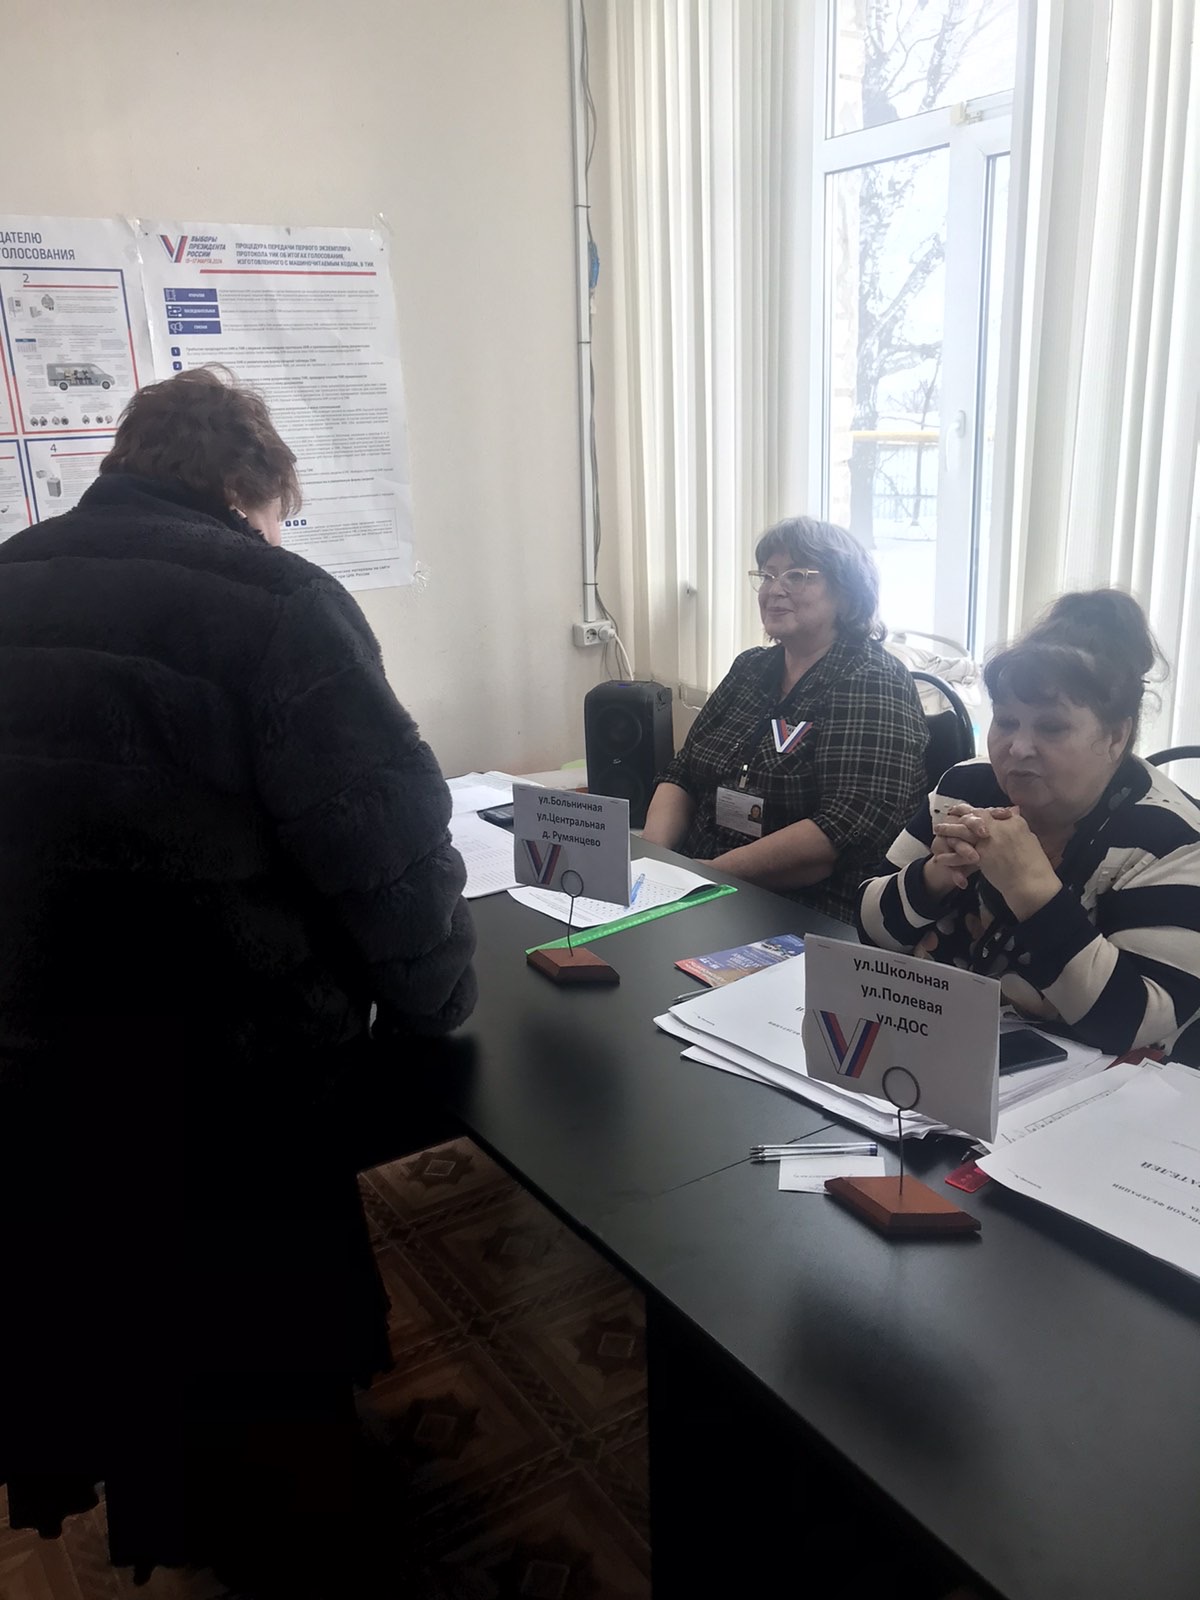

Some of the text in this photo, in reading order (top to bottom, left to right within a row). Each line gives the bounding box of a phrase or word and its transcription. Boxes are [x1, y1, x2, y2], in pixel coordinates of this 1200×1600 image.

[191, 235, 218, 243] ВЫБОРЫ
[0, 247, 75, 260] ОЛОСОВАНИЯ
[22, 273, 30, 283] 2
[50, 443, 57, 453] 4
[538, 796, 603, 813] ул.Больничная
[536, 812, 606, 831] ул.Центральная
[542, 830, 601, 847] д. Румянцево
[853, 958, 949, 991] ул.Школьная
[861, 984, 943, 1015] ул.Полевая
[876, 1013, 929, 1037] ул.ДОС
